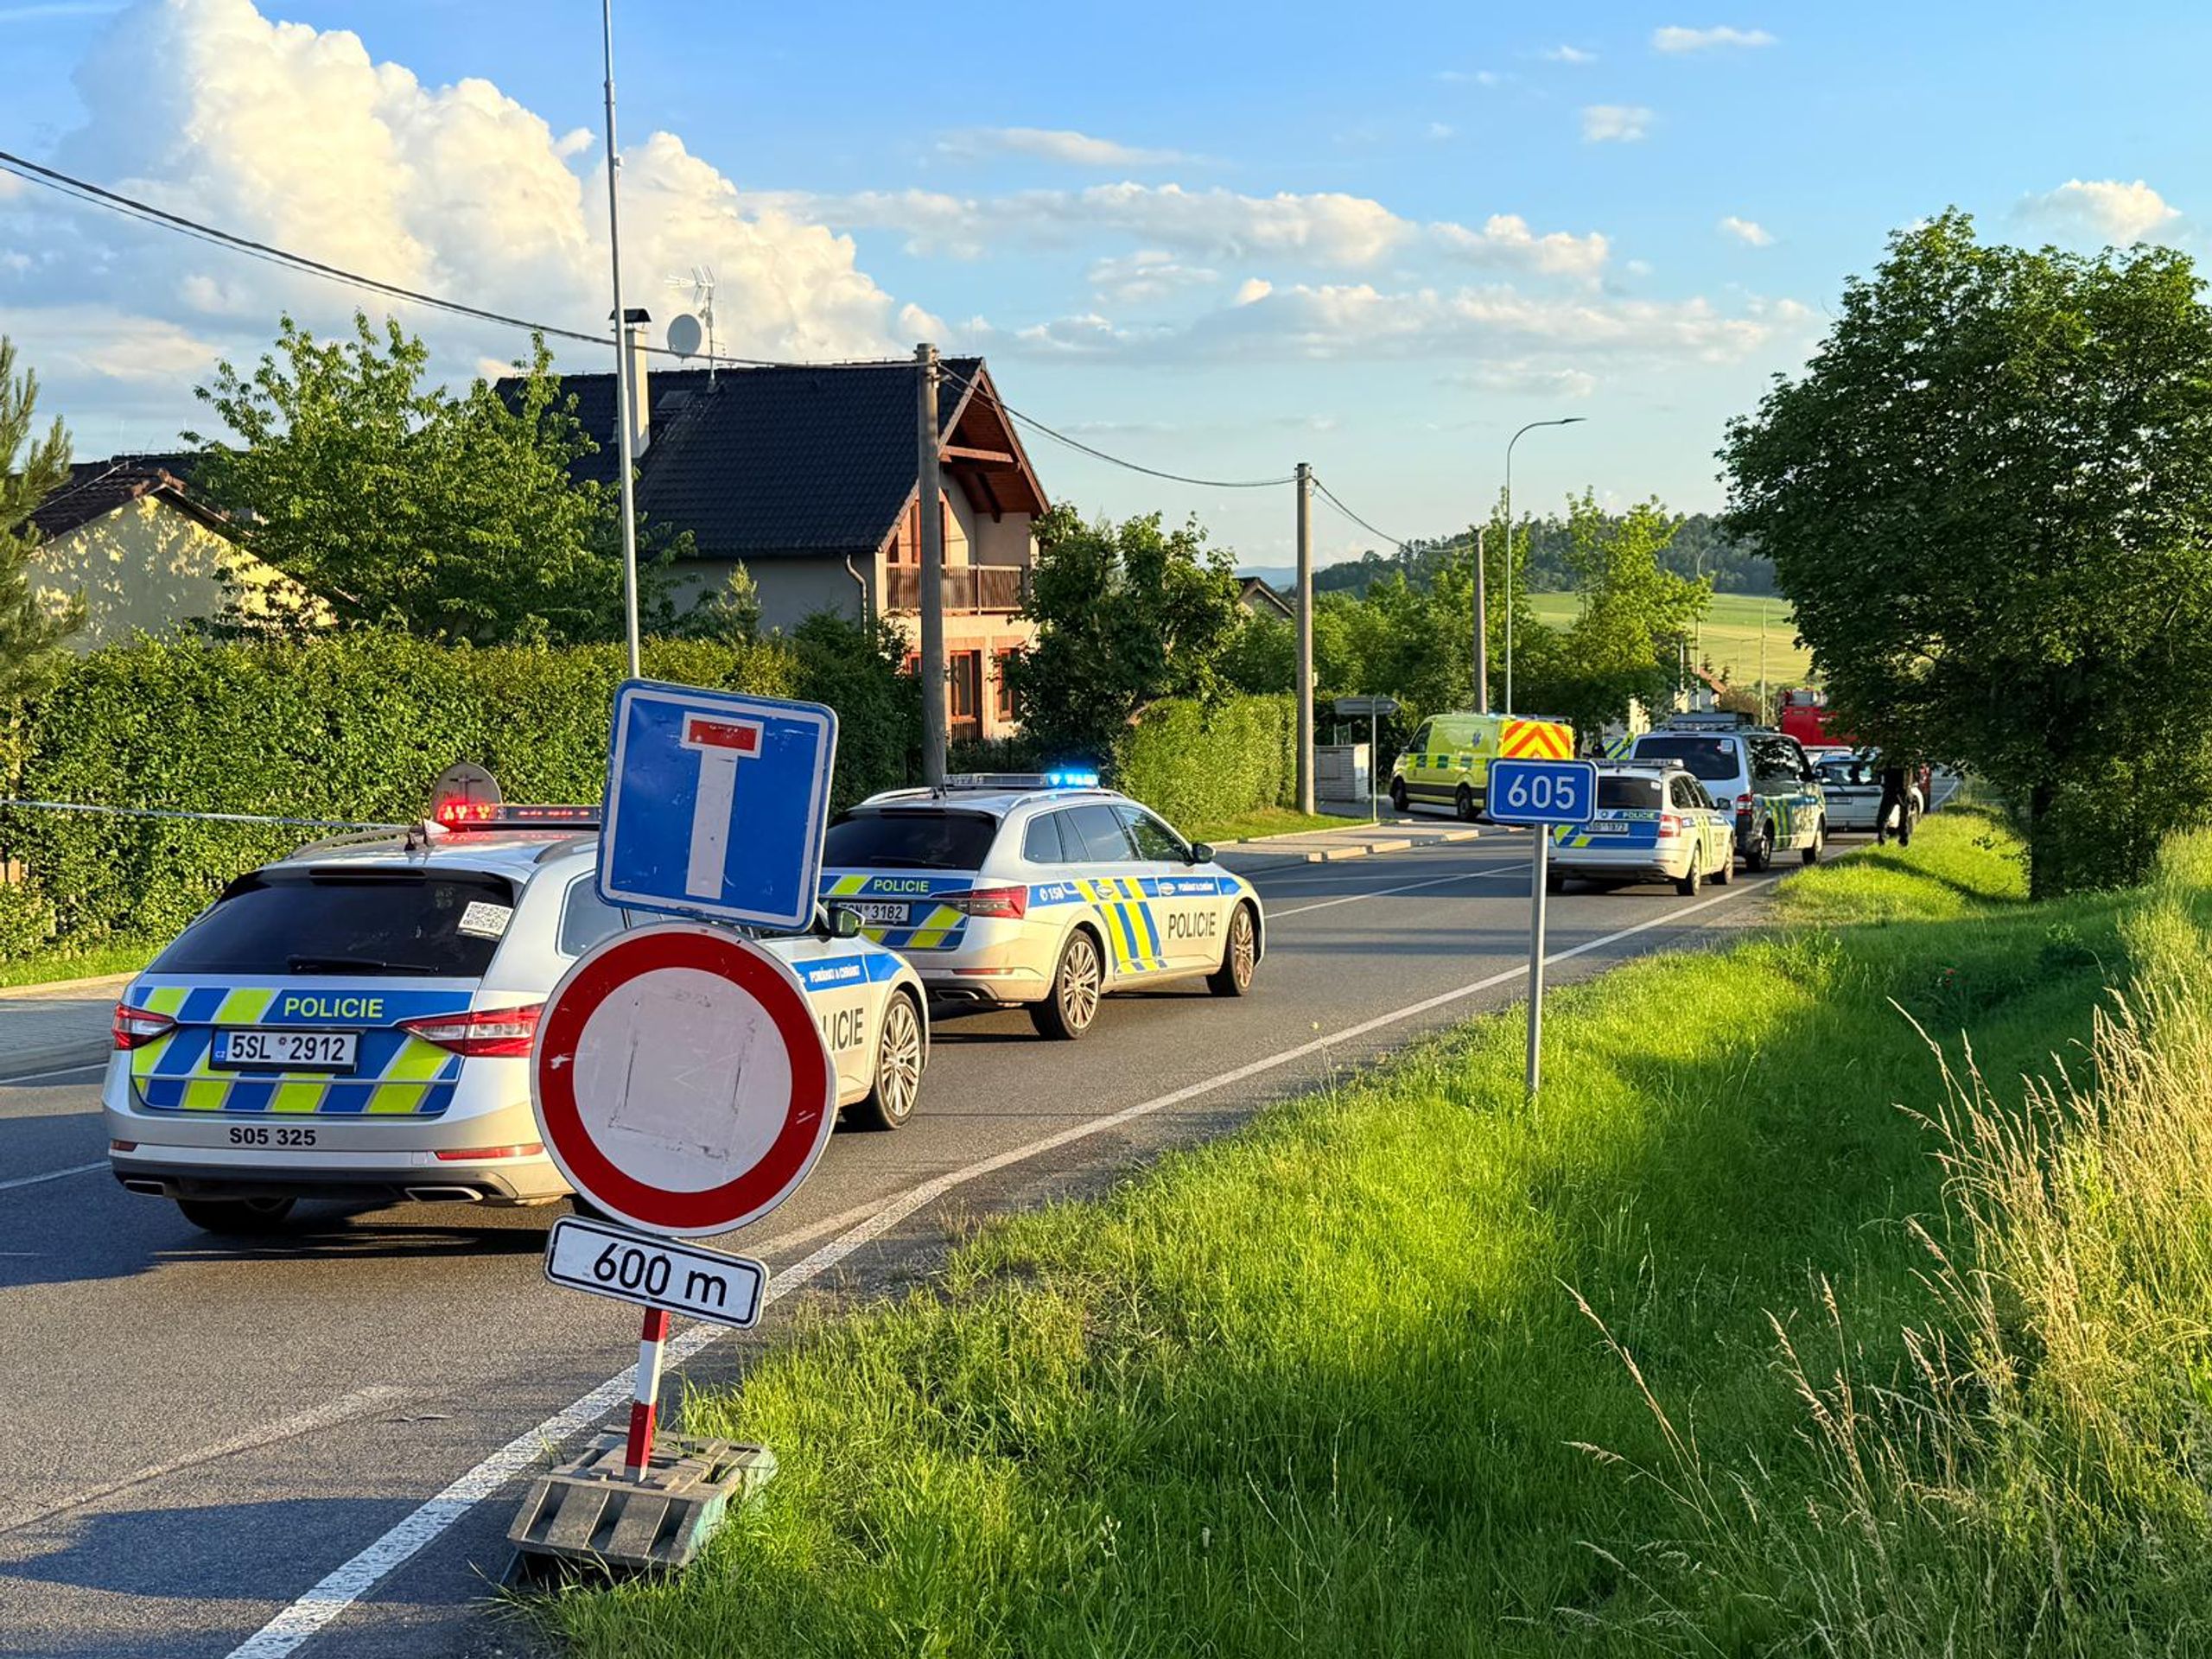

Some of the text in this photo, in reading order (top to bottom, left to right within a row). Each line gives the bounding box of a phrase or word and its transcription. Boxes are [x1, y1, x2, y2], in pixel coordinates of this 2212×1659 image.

[1508, 774, 1575, 810] 605
[874, 879, 930, 893] POLICIE
[871, 905, 903, 919] 3182
[1168, 912, 1217, 939] POLICIE
[284, 997, 385, 1018] POLICIE
[232, 1034, 345, 1061] 5SL 2912
[276, 1128, 316, 1146] 325
[594, 1243, 727, 1306] 600 m
